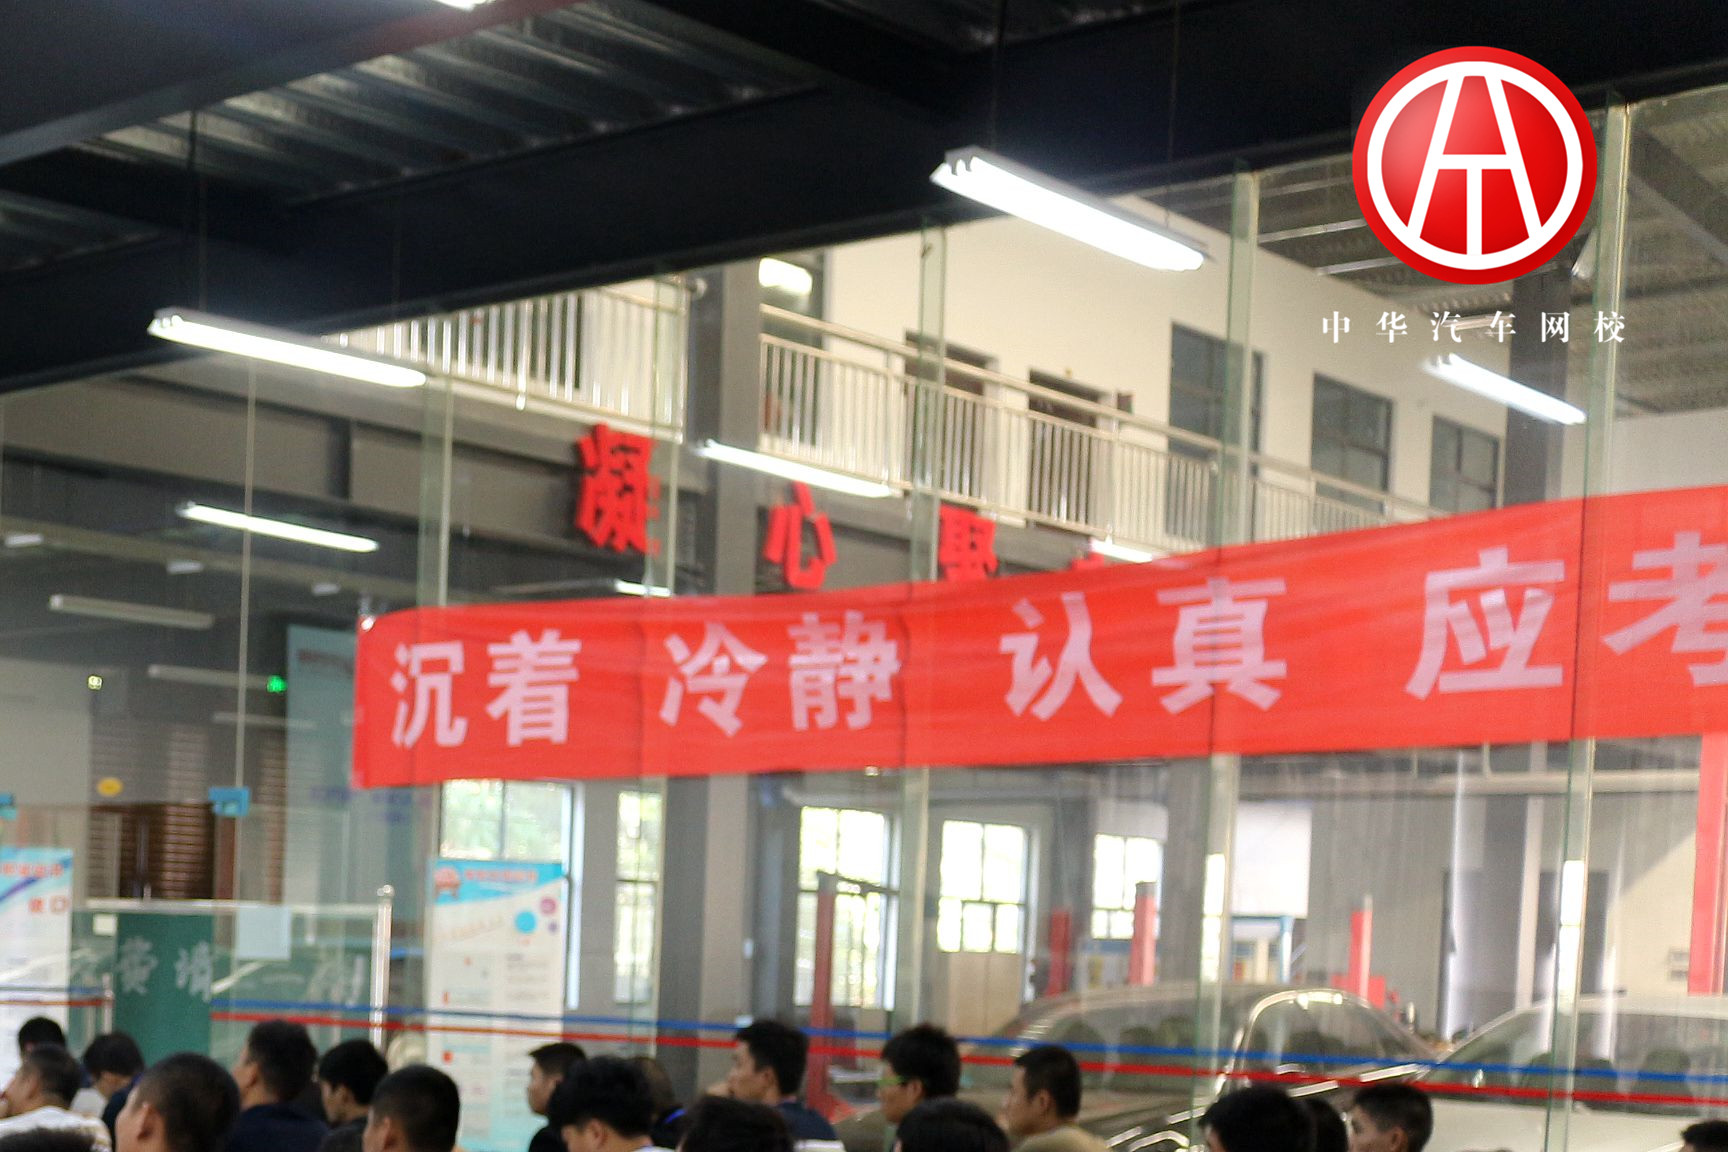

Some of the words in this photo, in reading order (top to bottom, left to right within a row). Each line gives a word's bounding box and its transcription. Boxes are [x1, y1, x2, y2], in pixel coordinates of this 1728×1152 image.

[389, 628, 583, 749] 沉着
[658, 609, 902, 737] 冷静
[999, 576, 1288, 721] 认真
[1404, 530, 1728, 700] 应考
